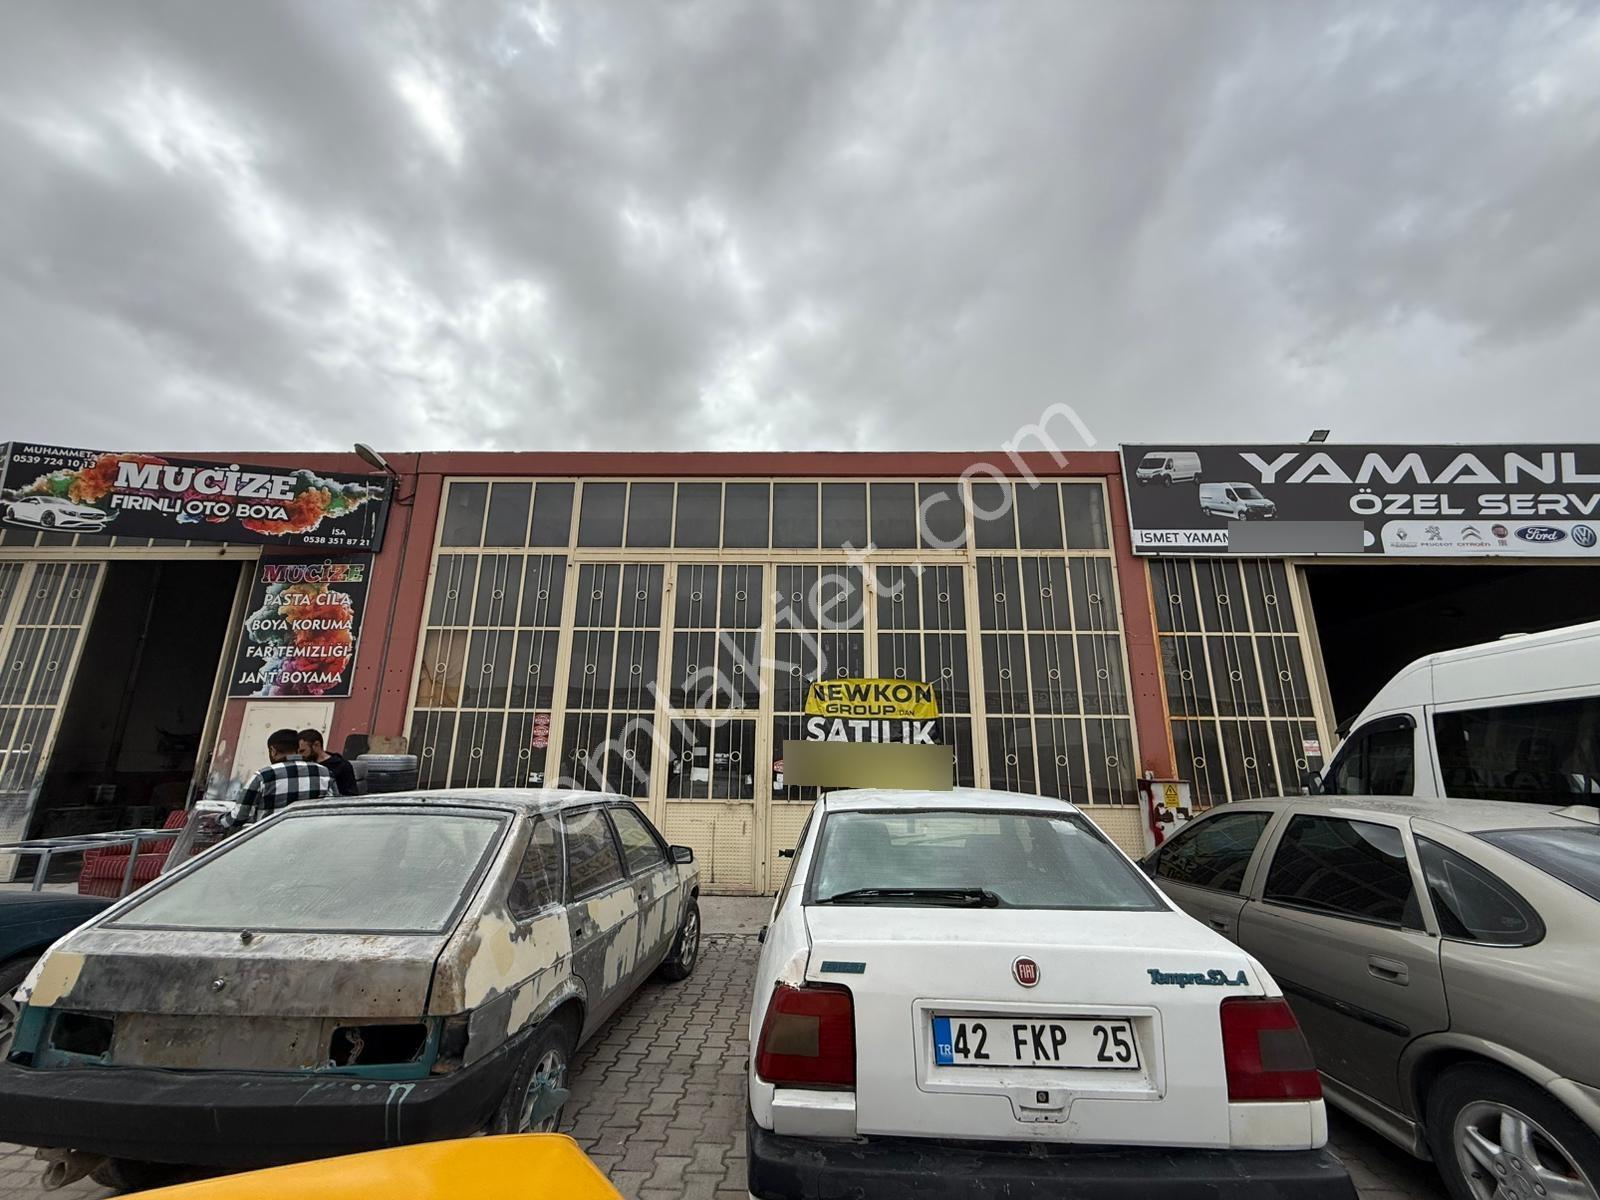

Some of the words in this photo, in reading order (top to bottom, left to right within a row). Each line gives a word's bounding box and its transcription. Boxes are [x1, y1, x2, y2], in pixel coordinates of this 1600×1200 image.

[23, 446, 94, 458] MUHAMMET
[12, 454, 41, 464] 0539
[44, 457, 64, 466] 724
[67, 459, 80, 468] 10
[83, 460, 97, 469] 13
[110, 494, 182, 513] FIRINLI
[186, 500, 231, 517] OTO
[235, 503, 289, 521] BOYA
[1349, 488, 1465, 516] ÖZEL
[1477, 493, 1600, 516] SERV
[303, 535, 326, 544] 0538
[327, 537, 344, 545] 351
[1525, 527, 1558, 542] Ford
[263, 593, 311, 606] PASTA
[252, 619, 288, 631] BOYA
[292, 619, 353, 631] KORUMA
[246, 645, 273, 658] FAR
[238, 671, 278, 684] JANT
[281, 671, 342, 684] BOYAMA
[814, 683, 932, 703] NEWKON
[825, 703, 896, 716] GROUP
[805, 716, 936, 744] SATILIK
[1019, 964, 1035, 979] FIAT
[953, 1022, 990, 1061] 42
[1013, 1023, 1068, 1061] FKP
[1092, 1025, 1133, 1062] 25
[938, 1043, 952, 1056] TR
